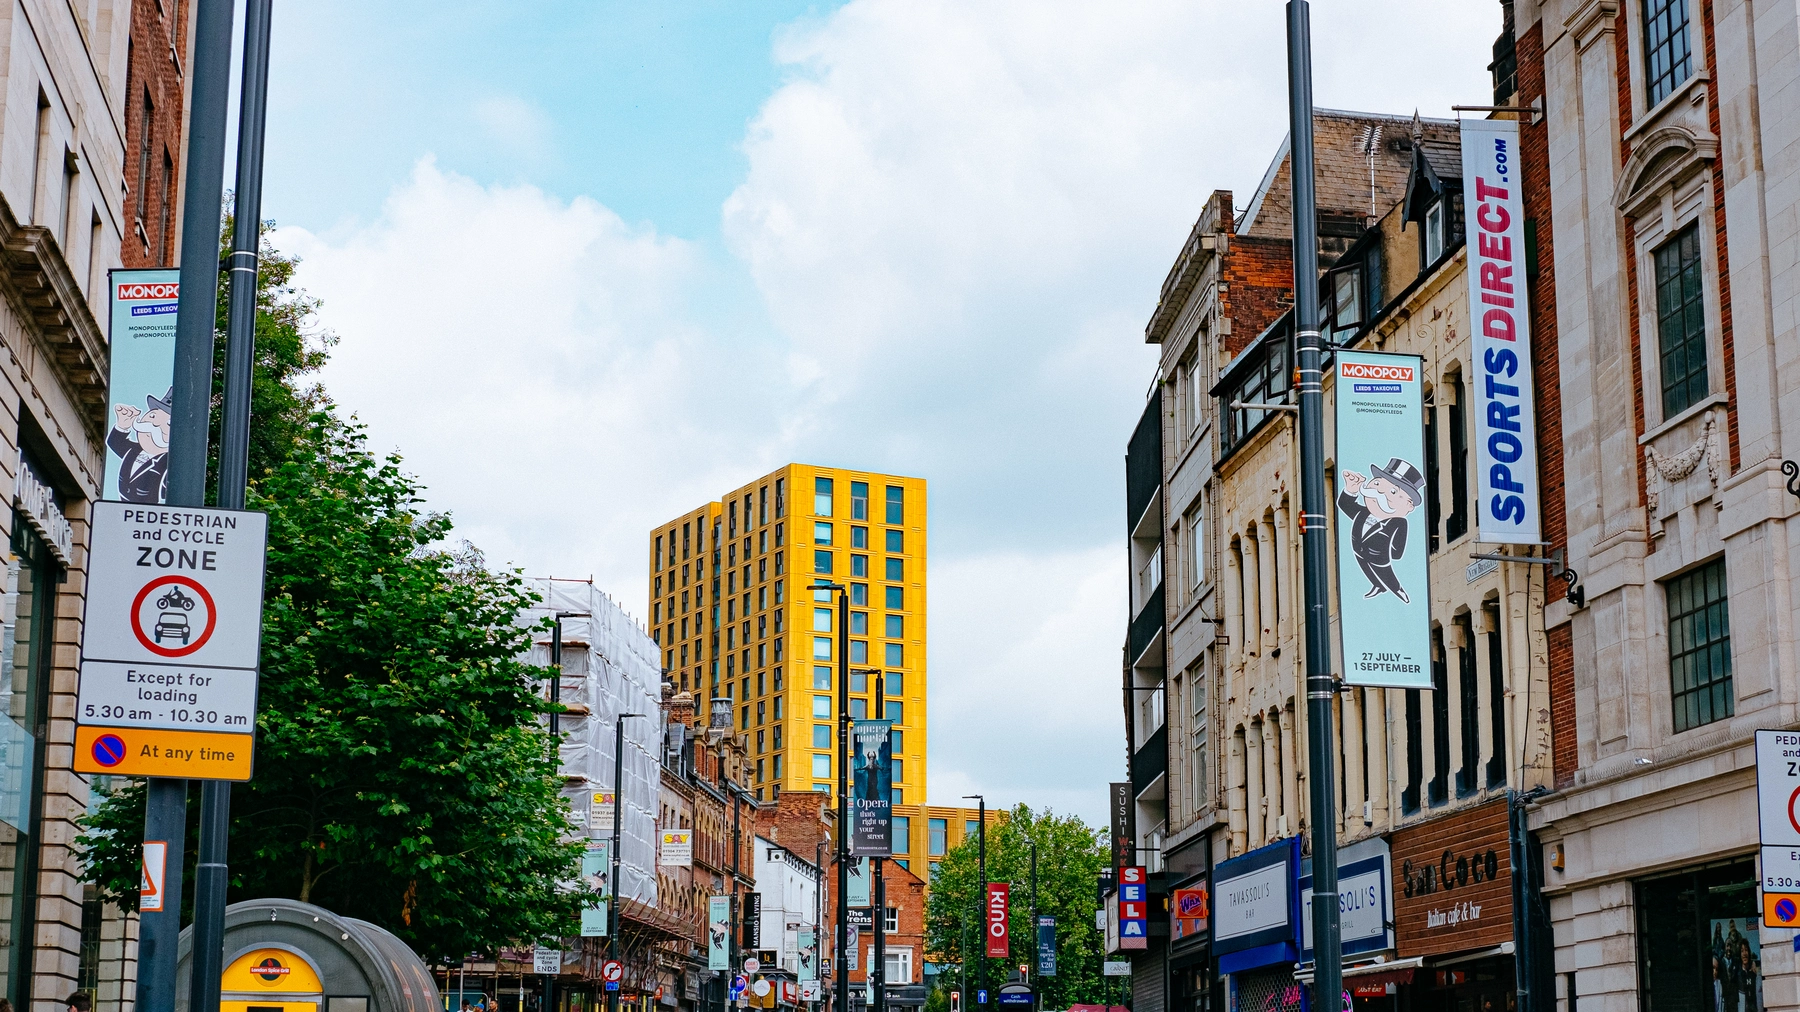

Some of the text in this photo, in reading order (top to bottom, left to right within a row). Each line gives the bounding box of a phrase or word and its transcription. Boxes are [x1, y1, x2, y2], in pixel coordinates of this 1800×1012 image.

[120, 286, 179, 298] MONOP
[1344, 365, 1411, 380] MONOPOLY
[124, 510, 236, 529] PEDESTRIAN
[133, 528, 225, 545] and CYCLE
[137, 546, 217, 571] ZONE
[1376, 653, 1401, 661] JULY
[1361, 663, 1420, 673] SEPTEMBER
[127, 670, 212, 686] Except for
[138, 688, 198, 705] loading
[85, 705, 124, 719] 5.30
[128, 708, 152, 720] am
[171, 709, 217, 723] 10.30
[224, 714, 247, 725] am
[1776, 736, 1800, 745] PED
[140, 745, 235, 761] At any time
[857, 798, 888, 809] Opera
[663, 834, 690, 844] SAY
[1403, 848, 1498, 898] San Coco
[1767, 878, 1792, 887] 5.30
[1124, 868, 1142, 935] SELA
[1230, 882, 1269, 907] TAVASSOLI'S
[1306, 886, 1375, 920] TSOLI'S
[1427, 908, 1446, 928] Italian
[1462, 902, 1468, 921] &
[1470, 901, 1481, 920] bar
[512, 944, 534, 953] VAPE
